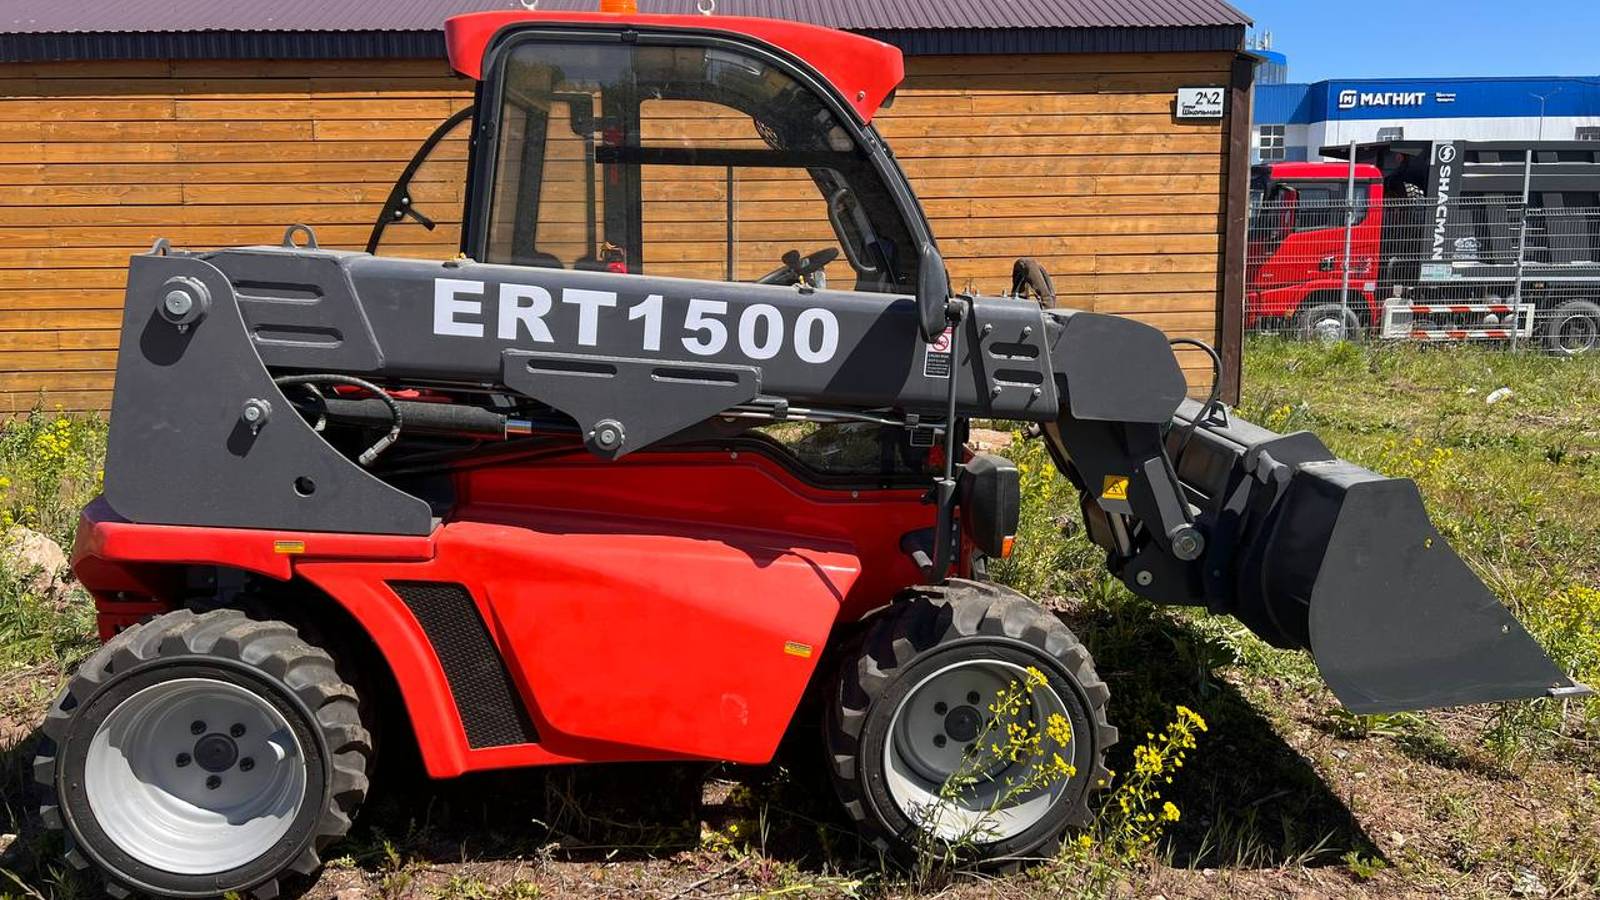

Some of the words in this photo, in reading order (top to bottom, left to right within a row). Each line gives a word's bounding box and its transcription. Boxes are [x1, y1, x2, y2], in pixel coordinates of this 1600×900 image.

[1360, 92, 1426, 105] МАГНИТ
[1432, 165, 1451, 260] SHACMAN
[433, 278, 839, 363] ERT1500
